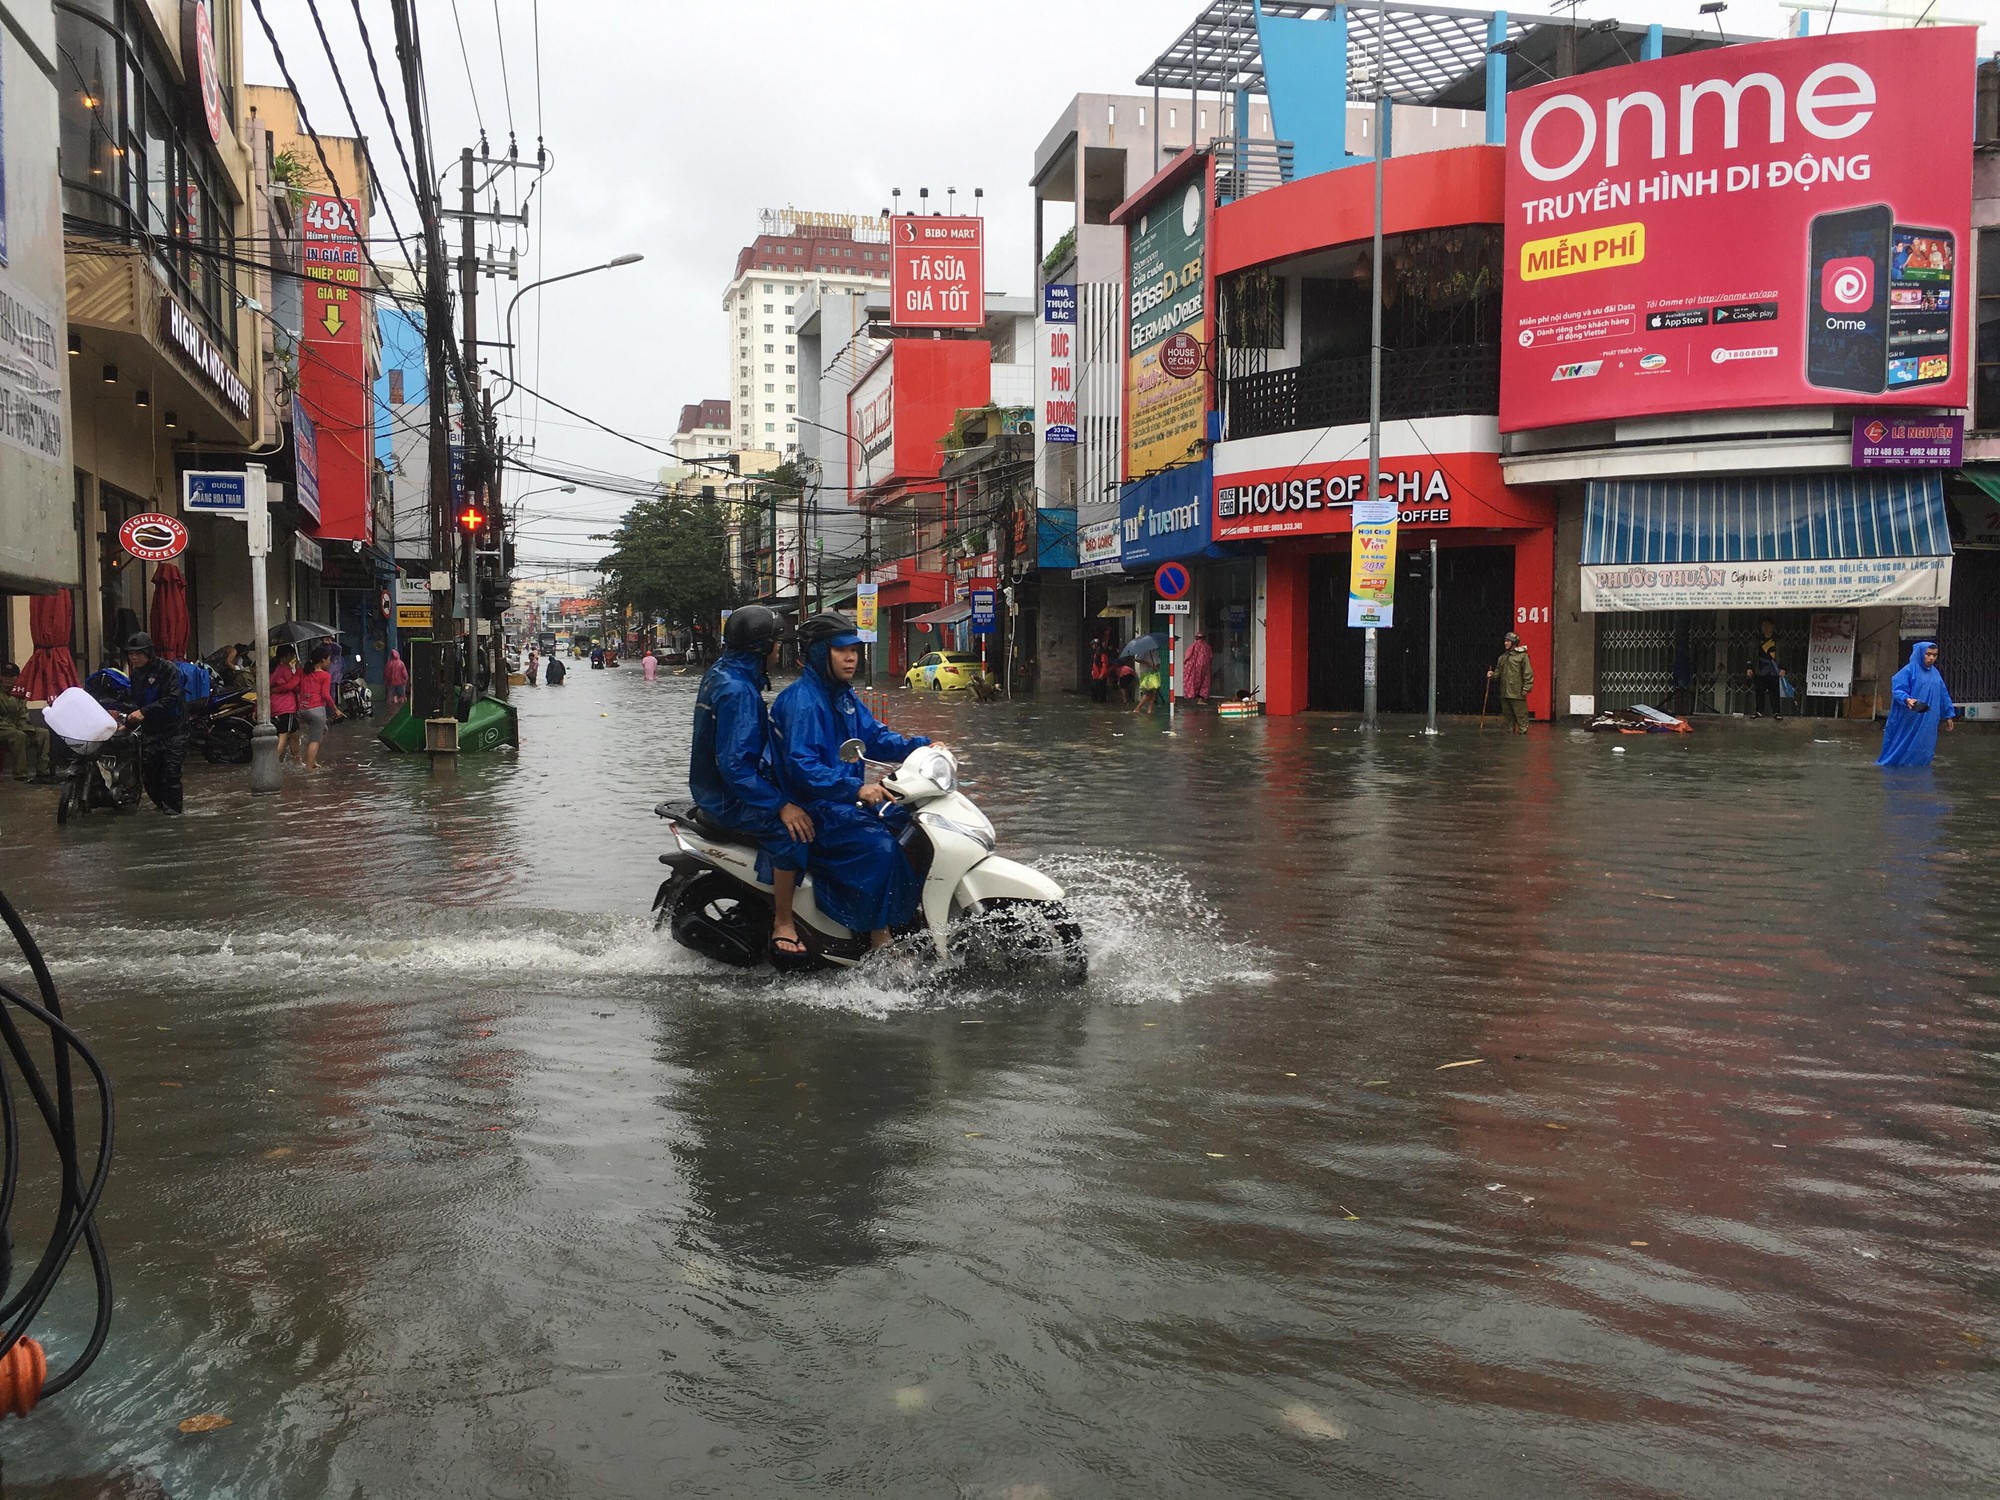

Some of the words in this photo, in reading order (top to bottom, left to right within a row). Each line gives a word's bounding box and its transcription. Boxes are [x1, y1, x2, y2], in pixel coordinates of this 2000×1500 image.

[1519, 62, 1877, 182] Onme
[1521, 177, 1631, 225] TRUYỀN
[1638, 169, 1718, 201] HÌNH
[1727, 164, 1760, 190] DI
[1767, 154, 1872, 194] ĐỘNG
[306, 200, 358, 231] 434
[925, 228, 947, 238] BIBO
[950, 229, 976, 239] MART
[306, 248, 319, 260] IN
[322, 248, 340, 262] GIÁ
[1527, 236, 1588, 274] MIỄN
[1592, 229, 1636, 267] PHÍ
[909, 255, 932, 281] TÃ
[934, 255, 966, 281] SỮA
[317, 286, 334, 300] GIÁ
[906, 286, 933, 311] GIÁ
[939, 284, 970, 311] TỐT
[1051, 287, 1069, 297] NHÀ
[1046, 298, 1075, 308] THUỐC
[1659, 299, 1683, 307] Onme
[1051, 308, 1069, 319] BẮC
[1537, 314, 1550, 325] phí
[1550, 313, 1562, 323] nội
[1563, 311, 1581, 320] dung
[1582, 309, 1592, 317] và
[1617, 303, 1636, 312] Data
[1732, 310, 1758, 321] Google
[1759, 309, 1774, 318] play
[1574, 323, 1586, 331] cho
[1664, 318, 1681, 328] App
[1682, 315, 1704, 325] Store
[1826, 317, 1866, 330] Onme
[1583, 328, 1607, 338] Viettel
[1050, 327, 1069, 357] ĐỨC
[171, 299, 225, 392] HIGHLANDS
[226, 368, 250, 420] COFFEE
[1167, 348, 1195, 357] HOUSE
[1728, 349, 1774, 358] 18008098
[1177, 357, 1195, 366] CHA
[1618, 361, 1624, 369] &
[1051, 362, 1071, 391] PHÚ
[1046, 394, 1076, 425] ĐƯỜNG
[1907, 422, 1954, 439] NGUYỄN
[211, 481, 238, 490] ĐƯỜNG
[1238, 478, 1322, 515] HOUSE
[1326, 474, 1362, 503] OF
[1368, 469, 1450, 503] CHA
[124, 515, 184, 536] HIGHLANDS
[1123, 516, 1139, 542] TH
[131, 545, 178, 558] COFFEE
[1595, 566, 1658, 589] PHƯỚC
[1658, 565, 1727, 590] THUẬN
[1517, 606, 1549, 623] 341
